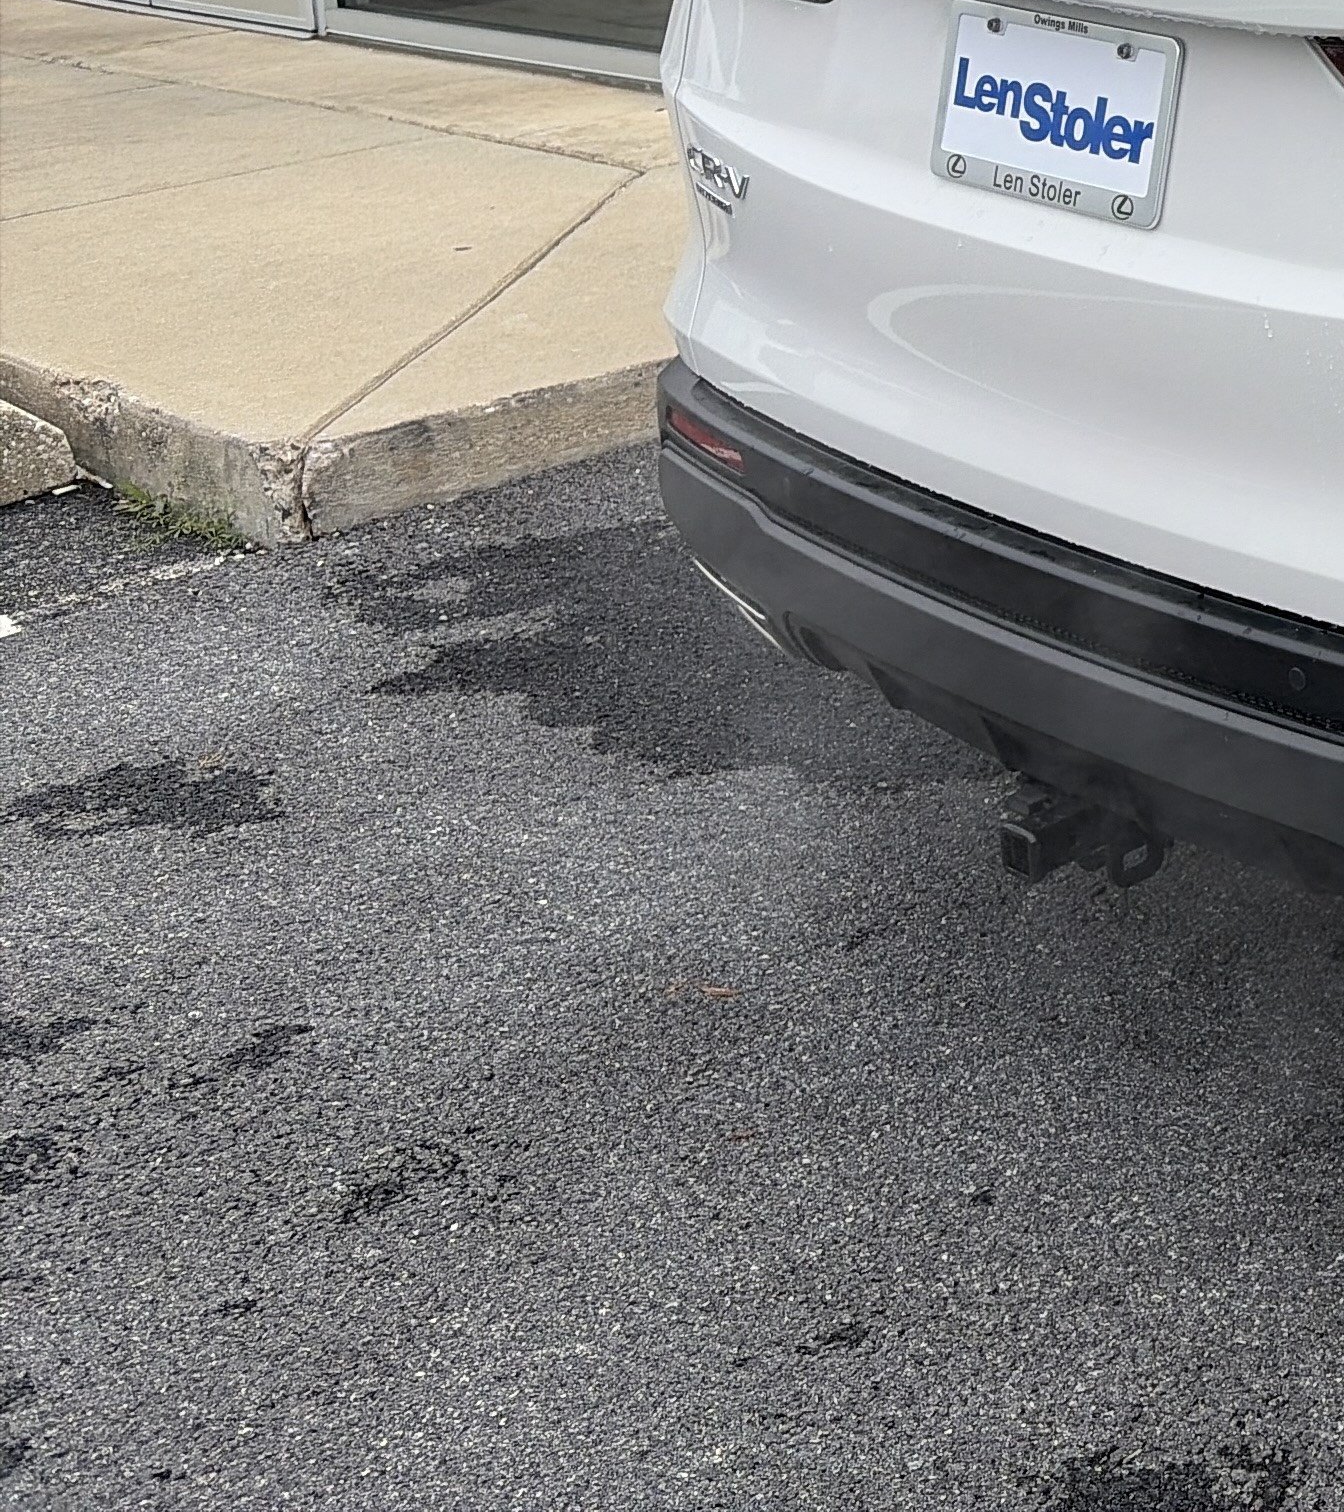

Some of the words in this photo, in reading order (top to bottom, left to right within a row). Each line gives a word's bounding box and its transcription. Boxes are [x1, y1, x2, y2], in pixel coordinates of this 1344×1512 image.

[1034, 13, 1065, 31] Owings
[1067, 20, 1088, 34] Mills
[687, 144, 750, 200] CR-V
[992, 165, 1023, 193] Len
[1028, 174, 1081, 207] Stoler
